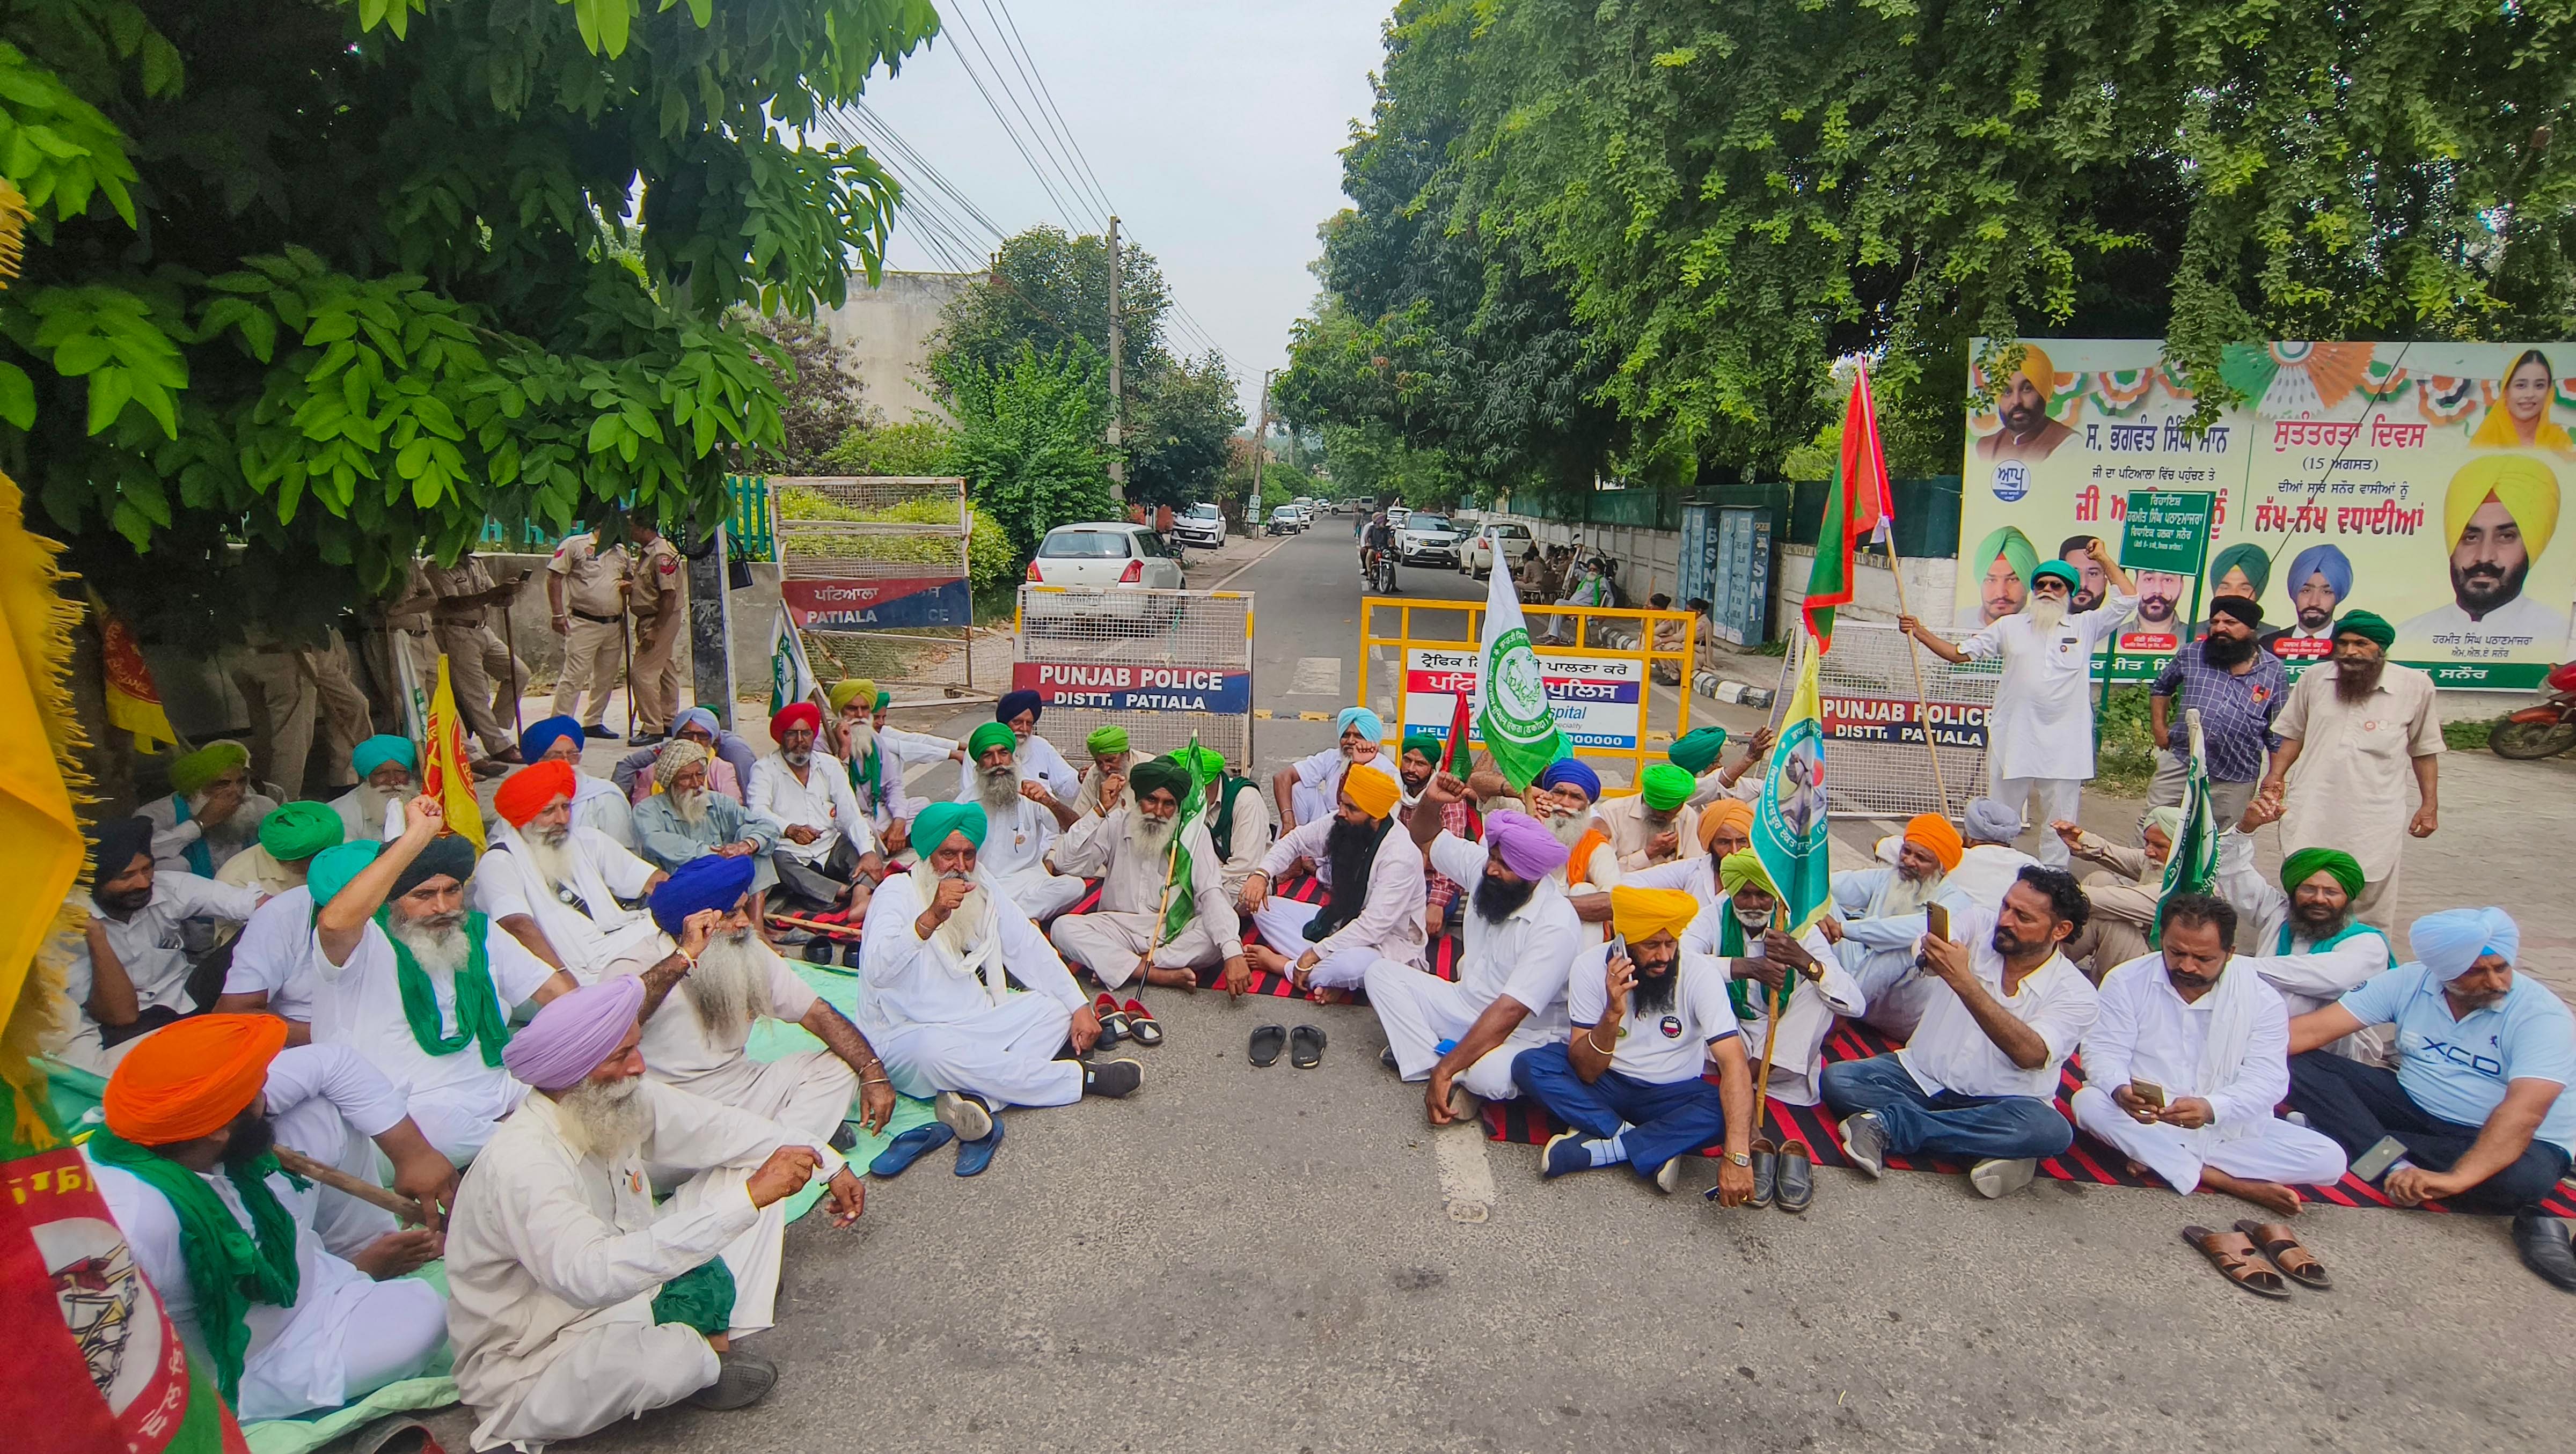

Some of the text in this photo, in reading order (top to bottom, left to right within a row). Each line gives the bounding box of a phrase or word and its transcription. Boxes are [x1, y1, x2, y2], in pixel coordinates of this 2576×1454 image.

[2085, 424, 2101, 451] ਸ.
[2110, 414, 2157, 451] ਭਗਵੰਤ
[2163, 415, 2192, 452] ਸਿੰਘ
[2274, 410, 2428, 452] ਸੁਤੰਤਰਤਾ ਦਿਵਸ
[2303, 457, 2324, 471] (15
[2092, 465, 2215, 483] ਜੀ ਦਾ ਪਟਿਆਲਾ ਵਿੱਚ ਪਹੁੰਚਣ ਤੇ
[2278, 479, 2303, 493] ਦੀਆਂ
[2331, 480, 2355, 494] ਸਨੌਰ
[2359, 481, 2396, 494] ਵਾਸੀਆਂ
[2400, 481, 2409, 500] ਨੂੰ
[2076, 484, 2099, 521] ਜੀ
[2127, 508, 2204, 525] ਹਰਮੀਤ ਸਿੰਘ ਪਠਾਣਮਾਜਰਾ
[2255, 496, 2424, 535] ਲੱਖ-ਲੱਖ ਵਧਾਈਆਂ
[2131, 525, 2155, 538] ਵਿਧਾਇਕ
[2176, 527, 2192, 540] ਸਨੌਰ
[814, 585, 879, 601] ਪਟਿਆਲਾ
[807, 610, 877, 623] PATIALA
[2432, 633, 2533, 645] ਹਰਮੀਤ ਸਿੰਘ ਪਠਾਣਮਾਜਰਾ
[2492, 647, 2509, 657] ਸਨੌਰ
[1421, 653, 1462, 669] ਟ੍ਰੈਫਿਕ
[1547, 662, 1598, 673] ਪਾਲਣਾ
[1603, 663, 1628, 675] ਕਰੋ
[1040, 665, 1224, 691] PUNJAB POLICE
[2439, 665, 2489, 679] ਸਨੌਰ
[1546, 678, 1619, 699] ਪੁਲਿਸ
[1053, 692, 1206, 710] DISTT. PATIALA
[1550, 706, 1587, 721] spital
[1823, 699, 1905, 722] PUNJAB
[1835, 724, 1888, 739] DISTT.
